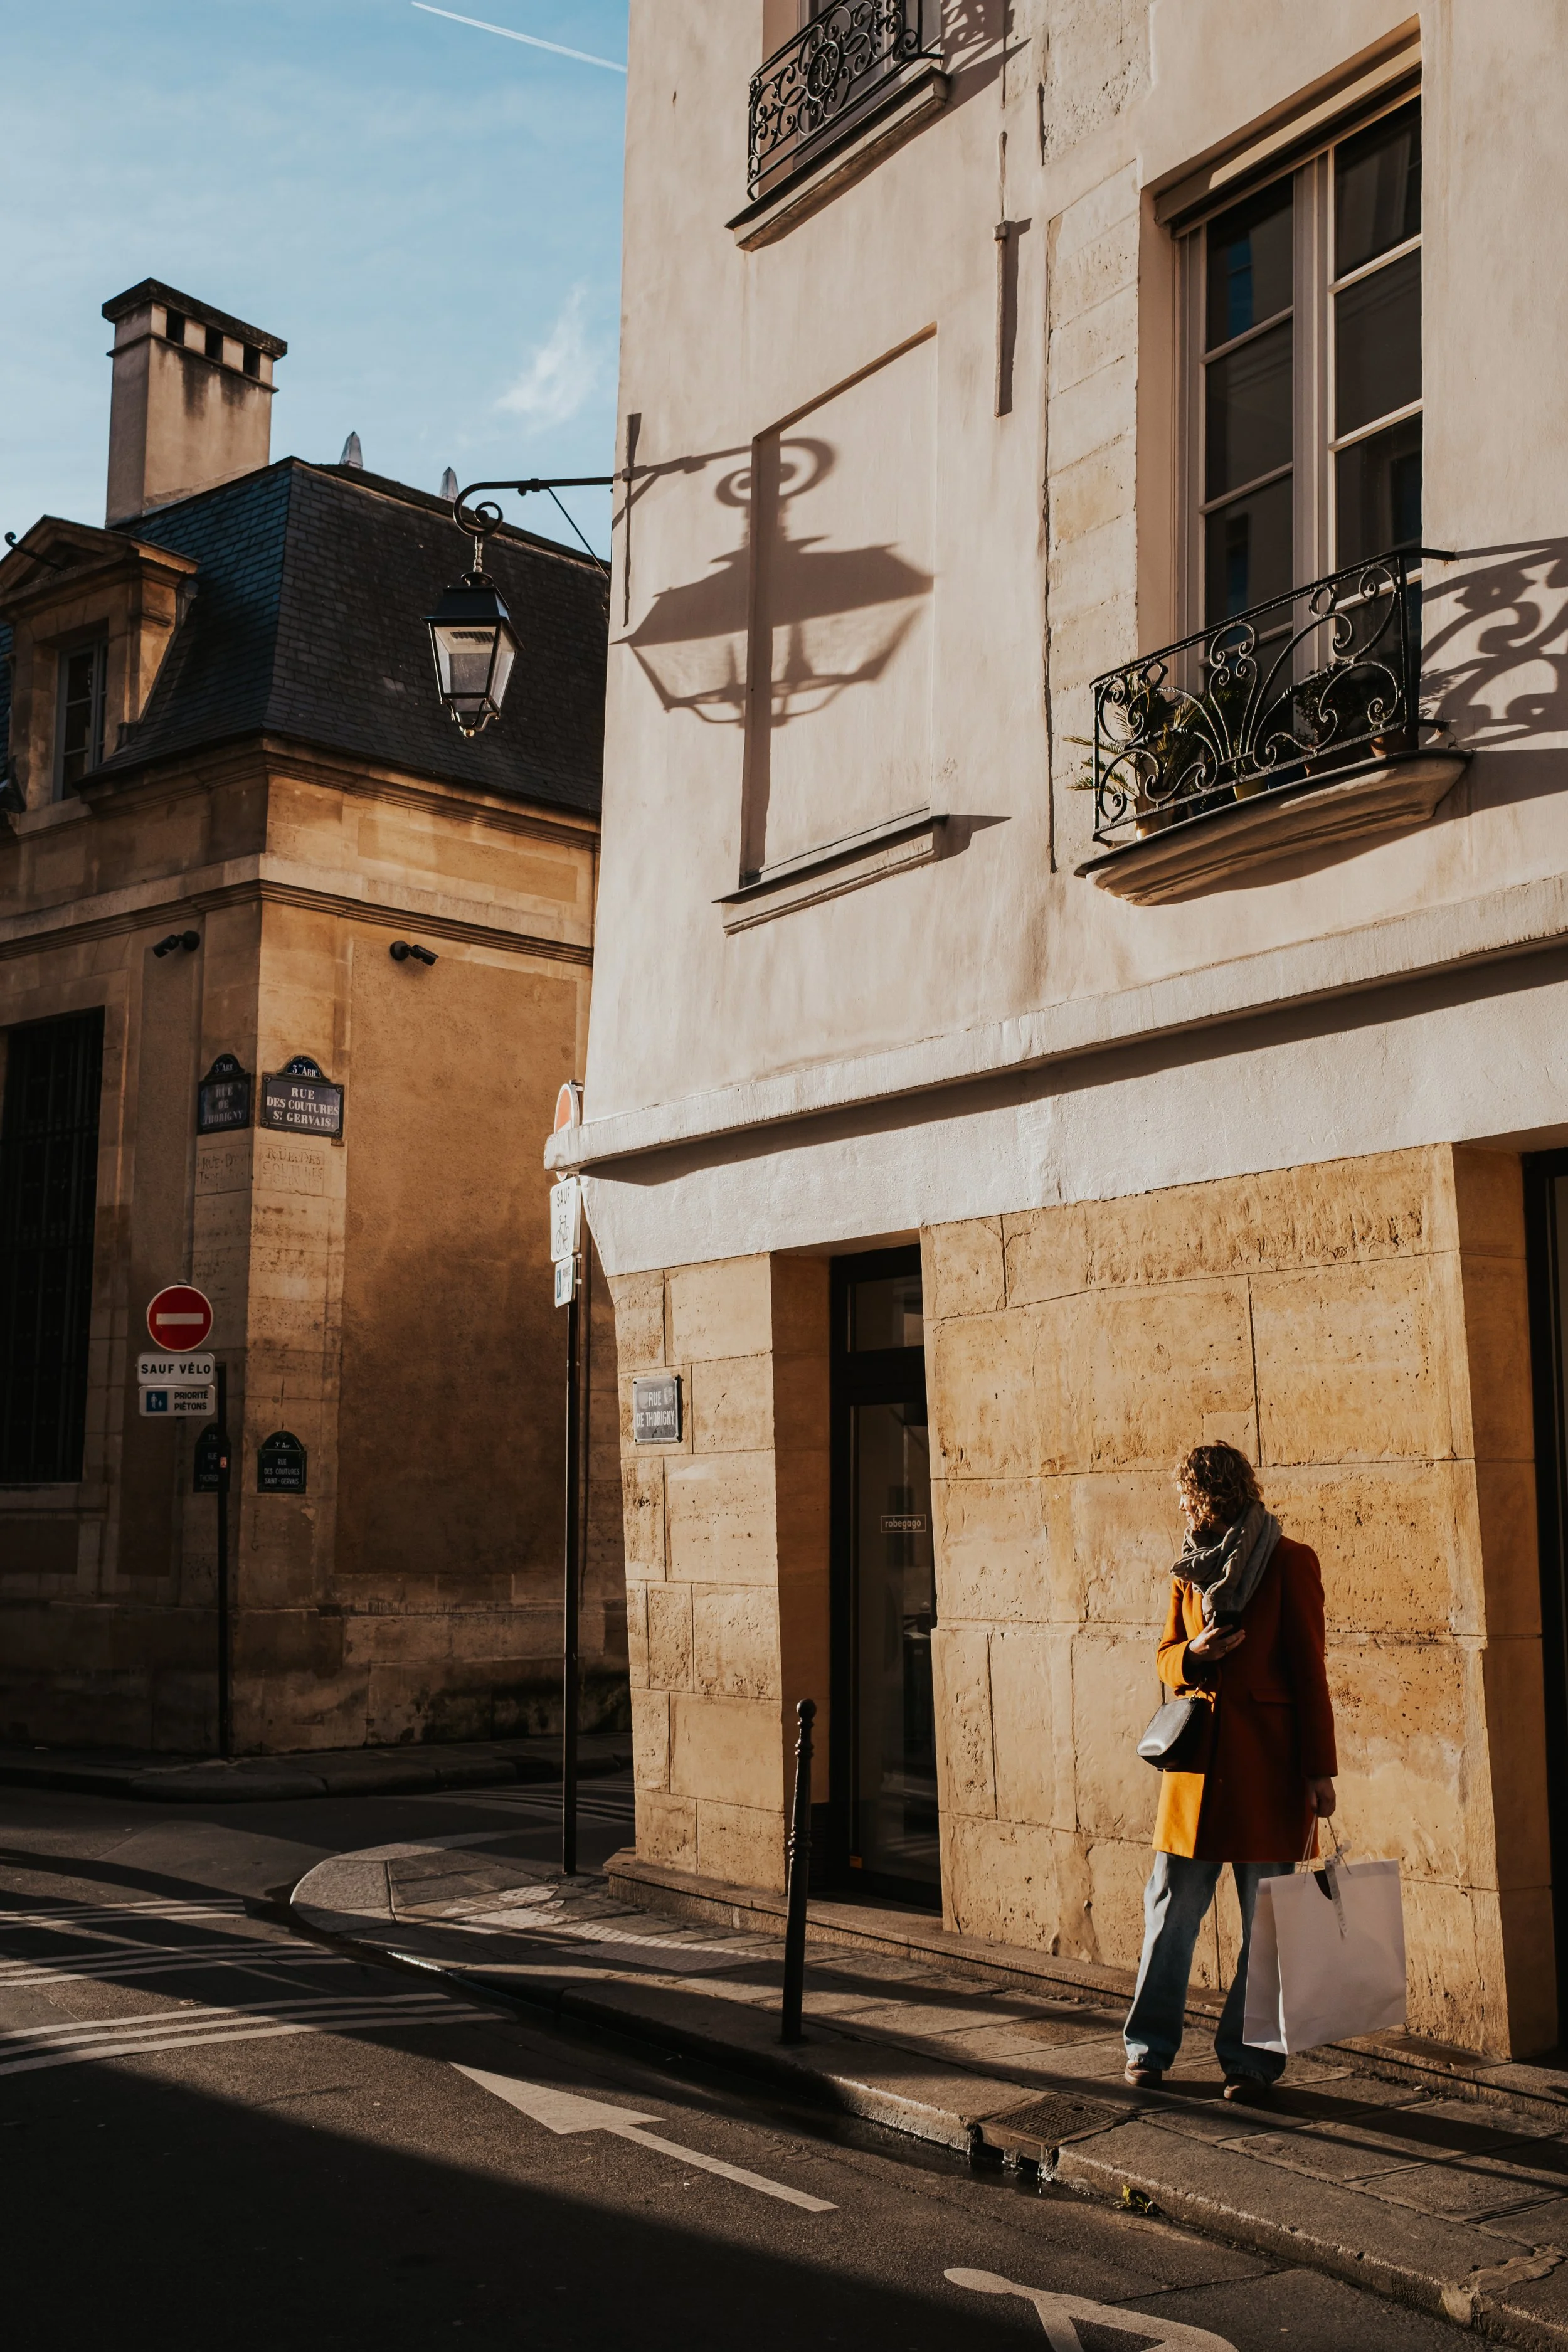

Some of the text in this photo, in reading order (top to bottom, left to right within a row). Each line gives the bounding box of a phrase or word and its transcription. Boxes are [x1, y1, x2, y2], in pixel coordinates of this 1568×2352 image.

[215, 1086, 233, 1098] RUE
[291, 1087, 315, 1099] RUE
[218, 1099, 229, 1109] DE
[267, 1096, 339, 1115] DES COUTURES
[204, 1110, 243, 1125] THORIGNY
[557, 1185, 570, 1207] SAUF
[141, 1362, 211, 1374] SAUF VÉLO
[174, 1389, 209, 1400] PRIORITÉ
[649, 1391, 662, 1406] RUE
[174, 1401, 207, 1411] PIÉTONS
[637, 1410, 675, 1428] DE THORIGNY
[207, 1453, 218, 1461] RUE
[199, 1474, 219, 1482] THORIG
[885, 1517, 921, 1530] robegago
